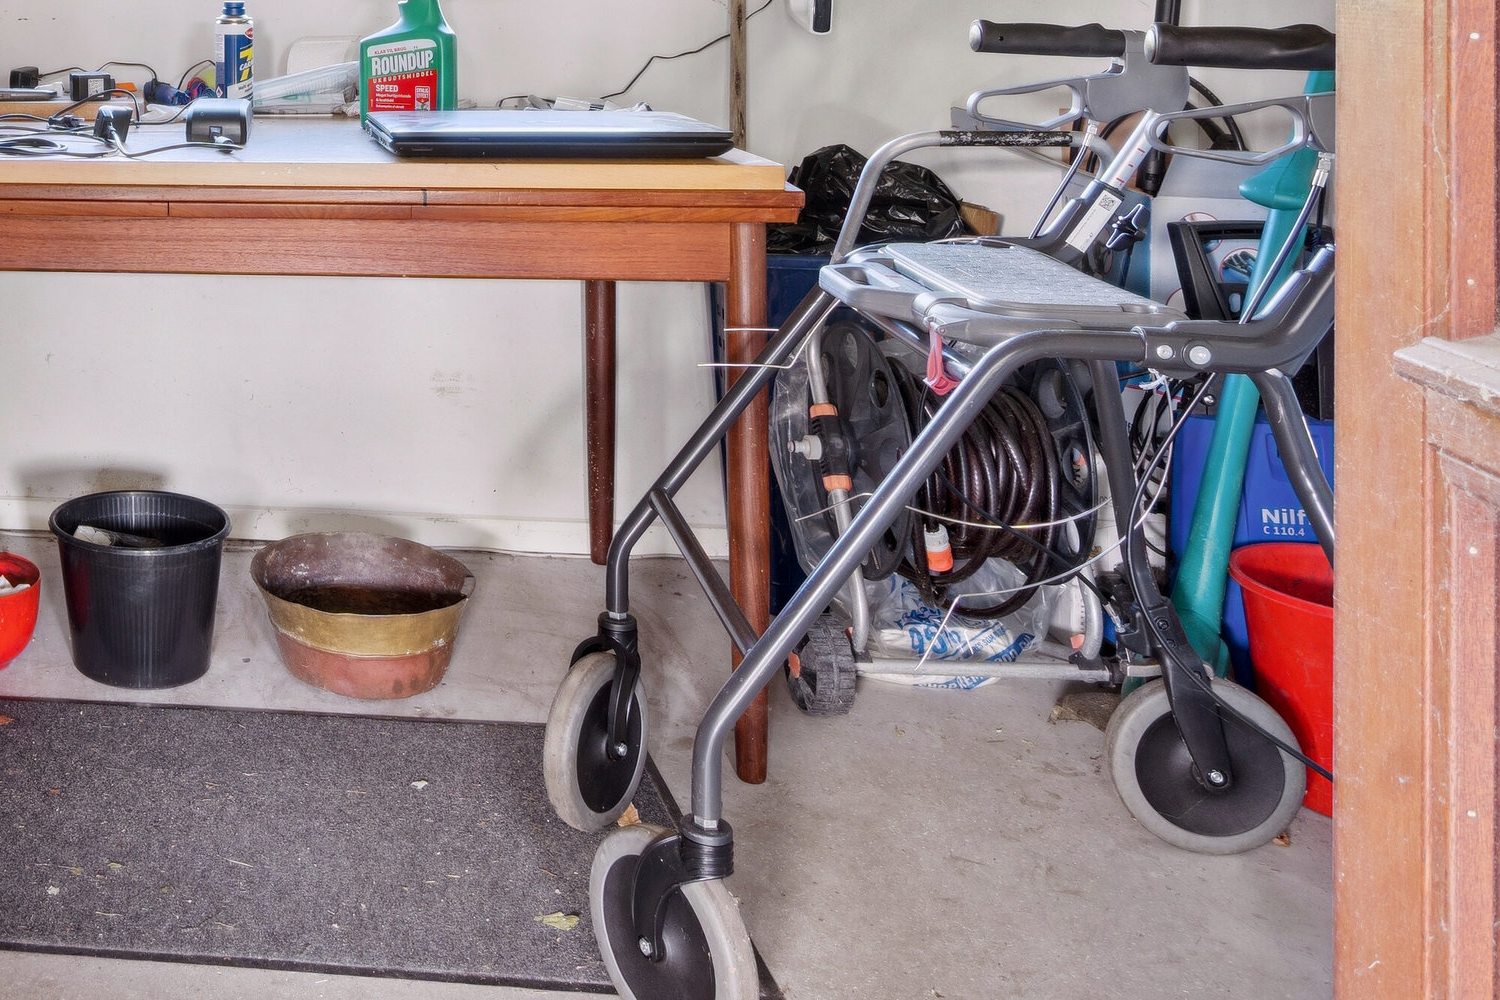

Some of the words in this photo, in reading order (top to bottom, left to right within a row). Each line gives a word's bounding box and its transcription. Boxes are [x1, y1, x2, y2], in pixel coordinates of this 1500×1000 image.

[372, 50, 434, 76] ROUNDUP
[372, 70, 434, 84] UKRUDTSMIDDEL
[375, 84, 399, 93] SPEED
[1261, 508, 1311, 526] Nilf
[1263, 526, 1270, 534] C
[1273, 526, 1306, 537] 110.4
